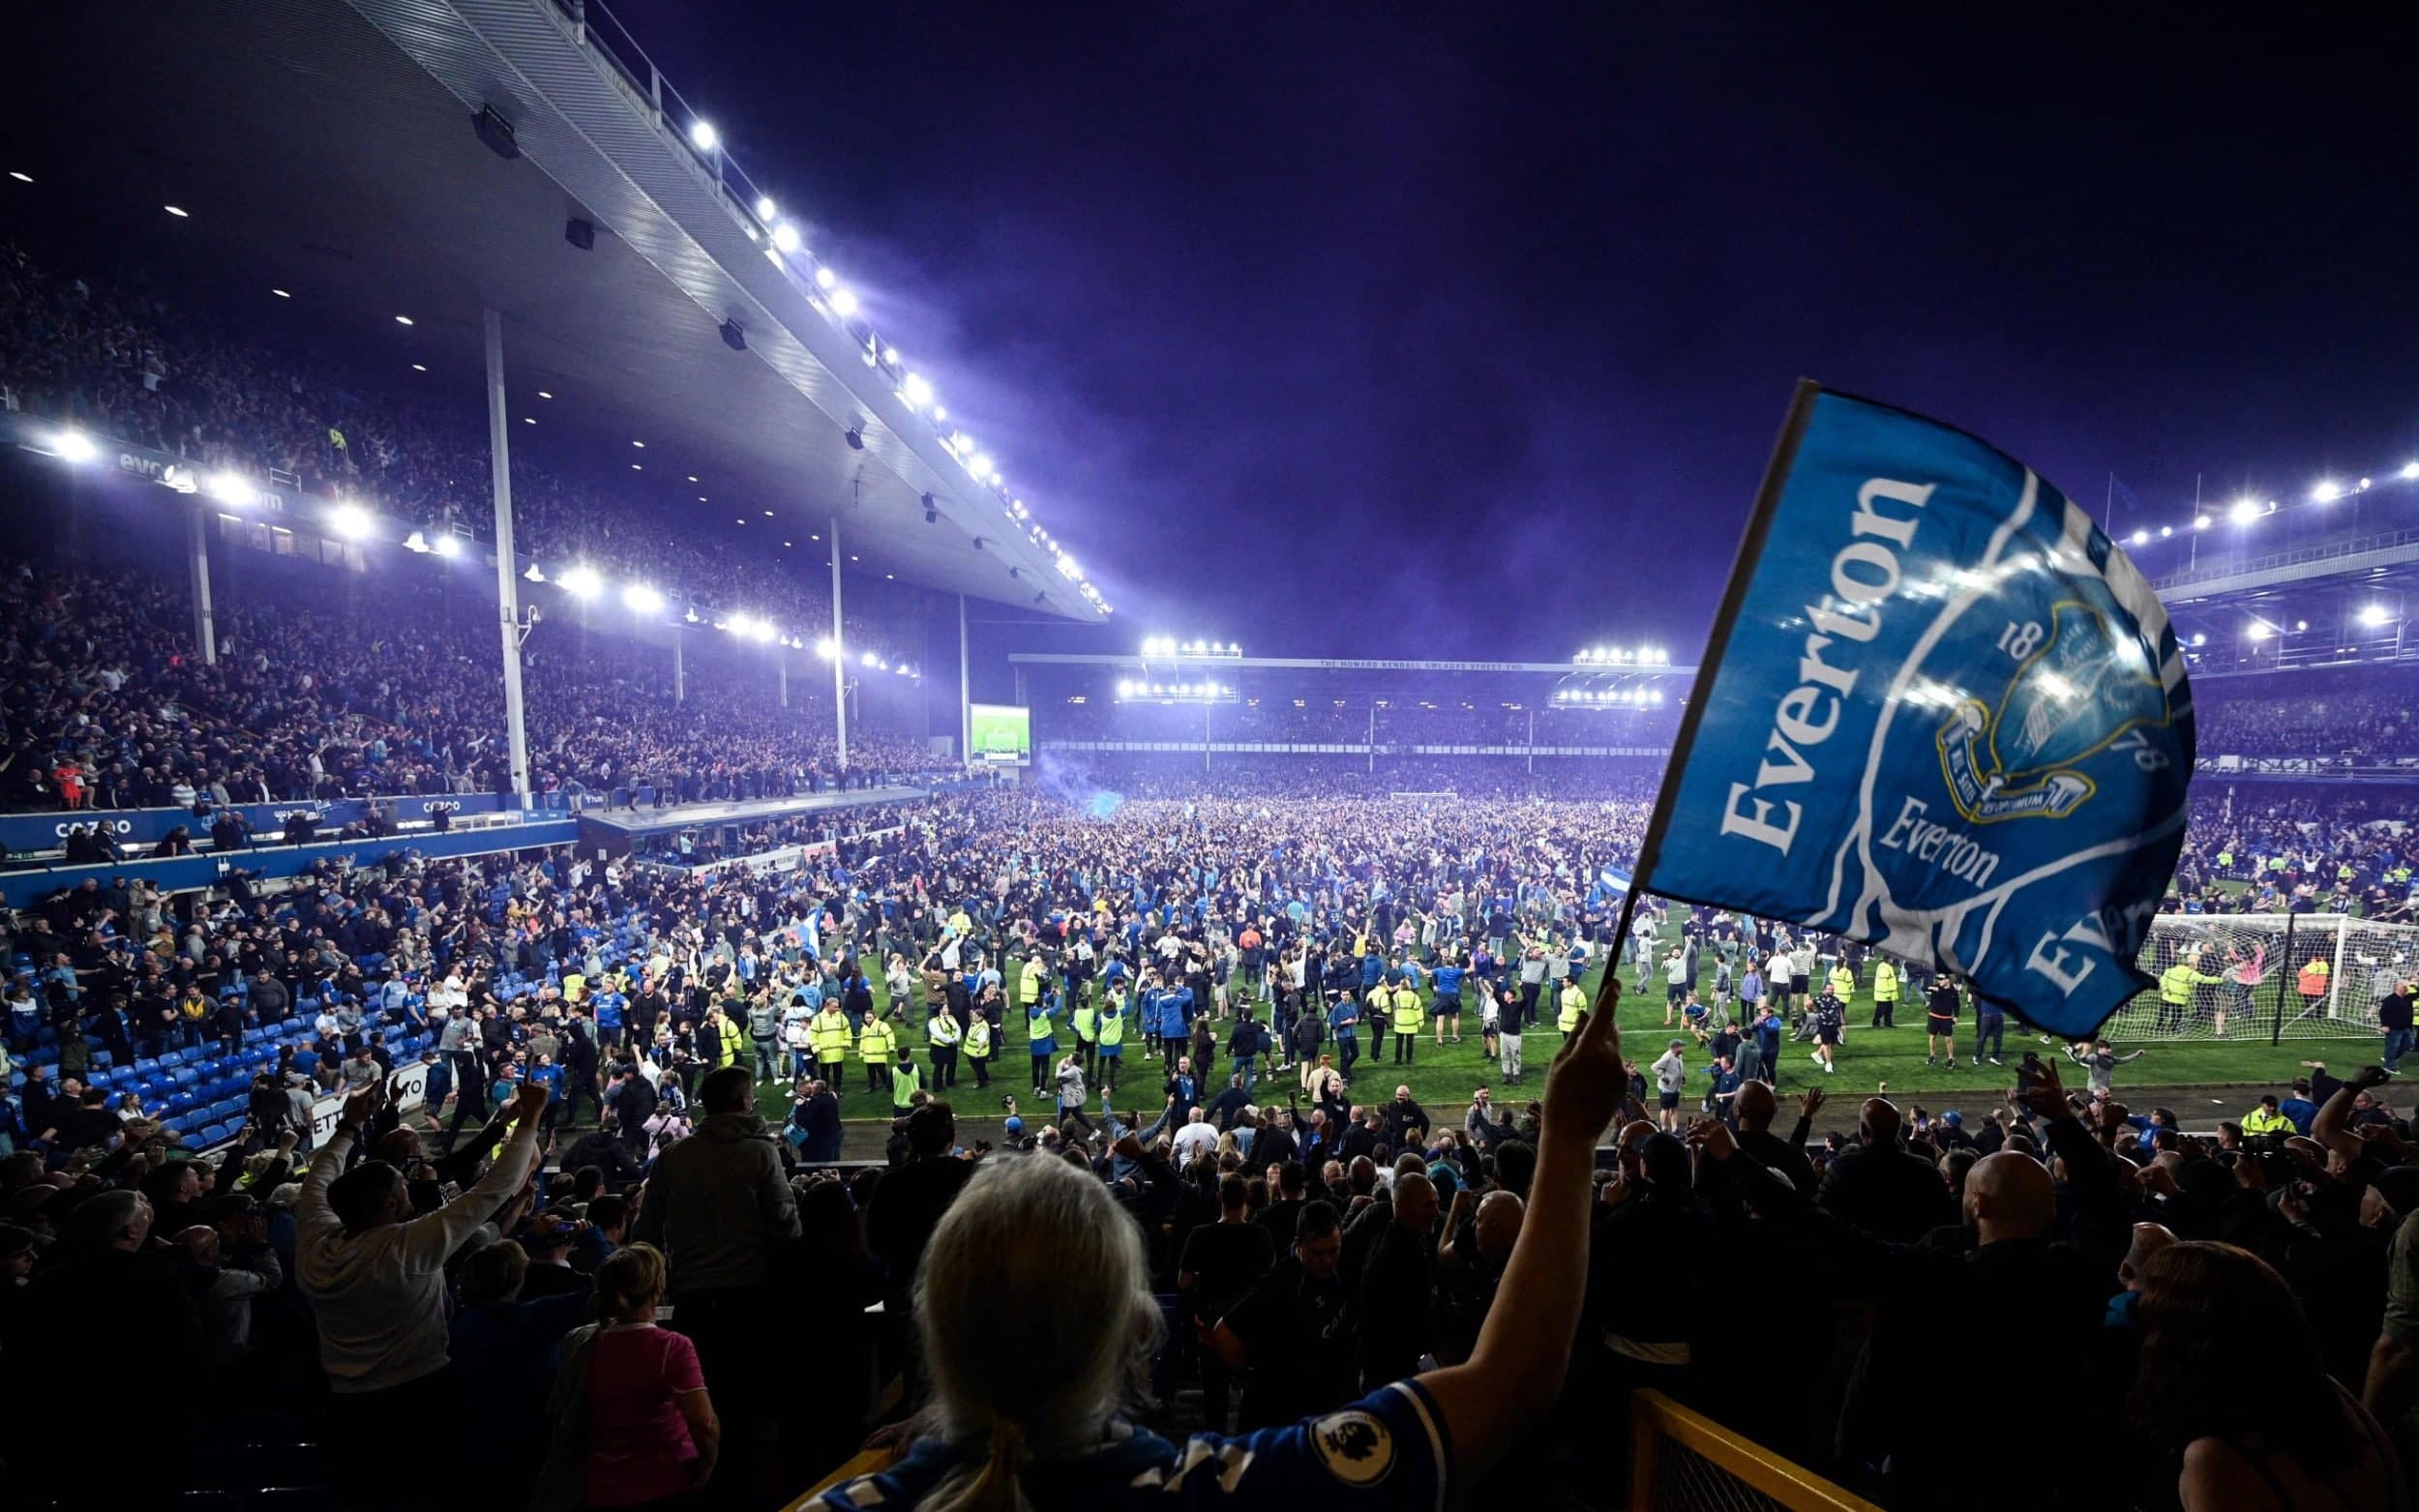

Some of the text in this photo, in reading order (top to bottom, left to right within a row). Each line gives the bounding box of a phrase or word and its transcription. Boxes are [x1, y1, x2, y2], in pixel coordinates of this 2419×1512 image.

[1996, 620, 2044, 660] 18
[1340, 660, 1379, 668] HOWARD
[1382, 661, 1421, 669] KENDALL
[1719, 477, 1937, 857] Everton
[2110, 727, 2169, 771] 78
[1879, 795, 2000, 889] Everton
[314, 1109, 343, 1135] ETT
